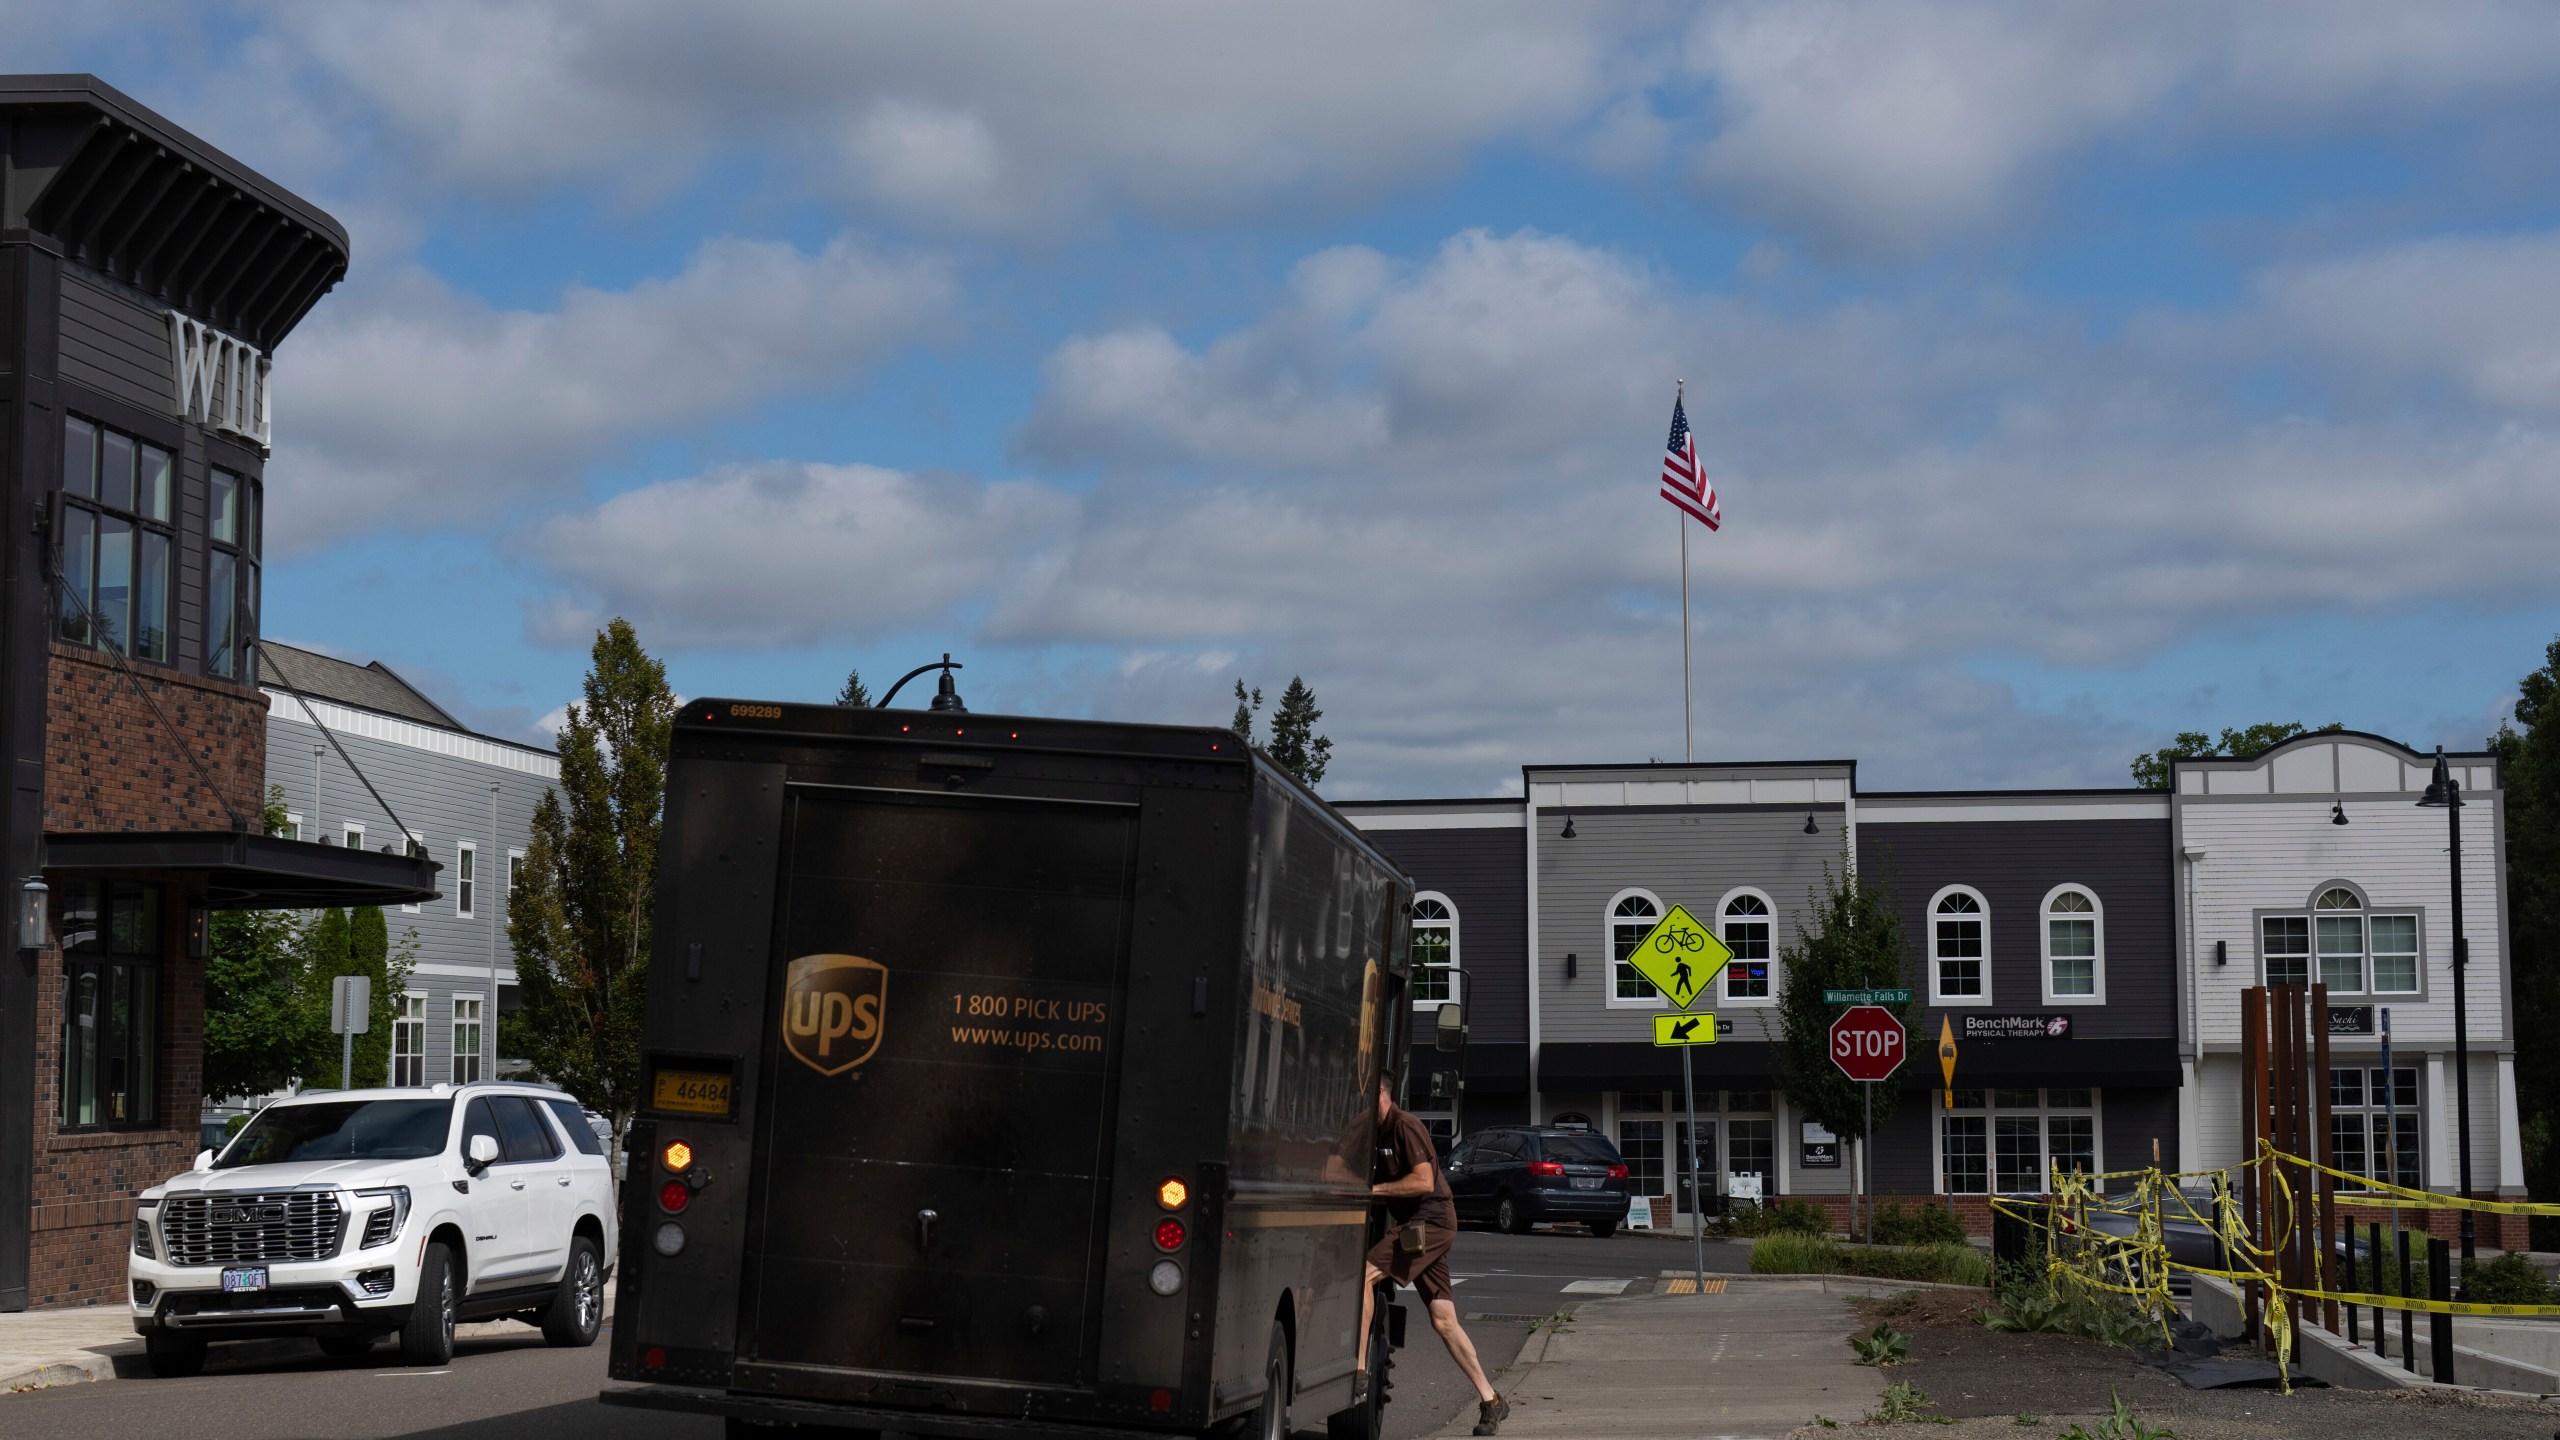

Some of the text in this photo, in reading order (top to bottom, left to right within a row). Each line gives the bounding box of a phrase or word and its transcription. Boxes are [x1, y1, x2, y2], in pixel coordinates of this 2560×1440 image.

[730, 704, 781, 719] 699289
[1750, 968, 1764, 976] Yoga
[1826, 991, 1908, 1002] Willamette Falls Dr
[953, 994, 1107, 1023] 1 800 PICK UPS
[791, 991, 878, 1056] ups
[1966, 1016, 2045, 1029] BenchMark
[951, 1027, 1102, 1052] www.ups.com
[1836, 1029, 1900, 1057] STOP
[677, 1081, 729, 1102] 46484
[212, 1206, 282, 1223] GMC
[224, 1274, 242, 1287] 087
